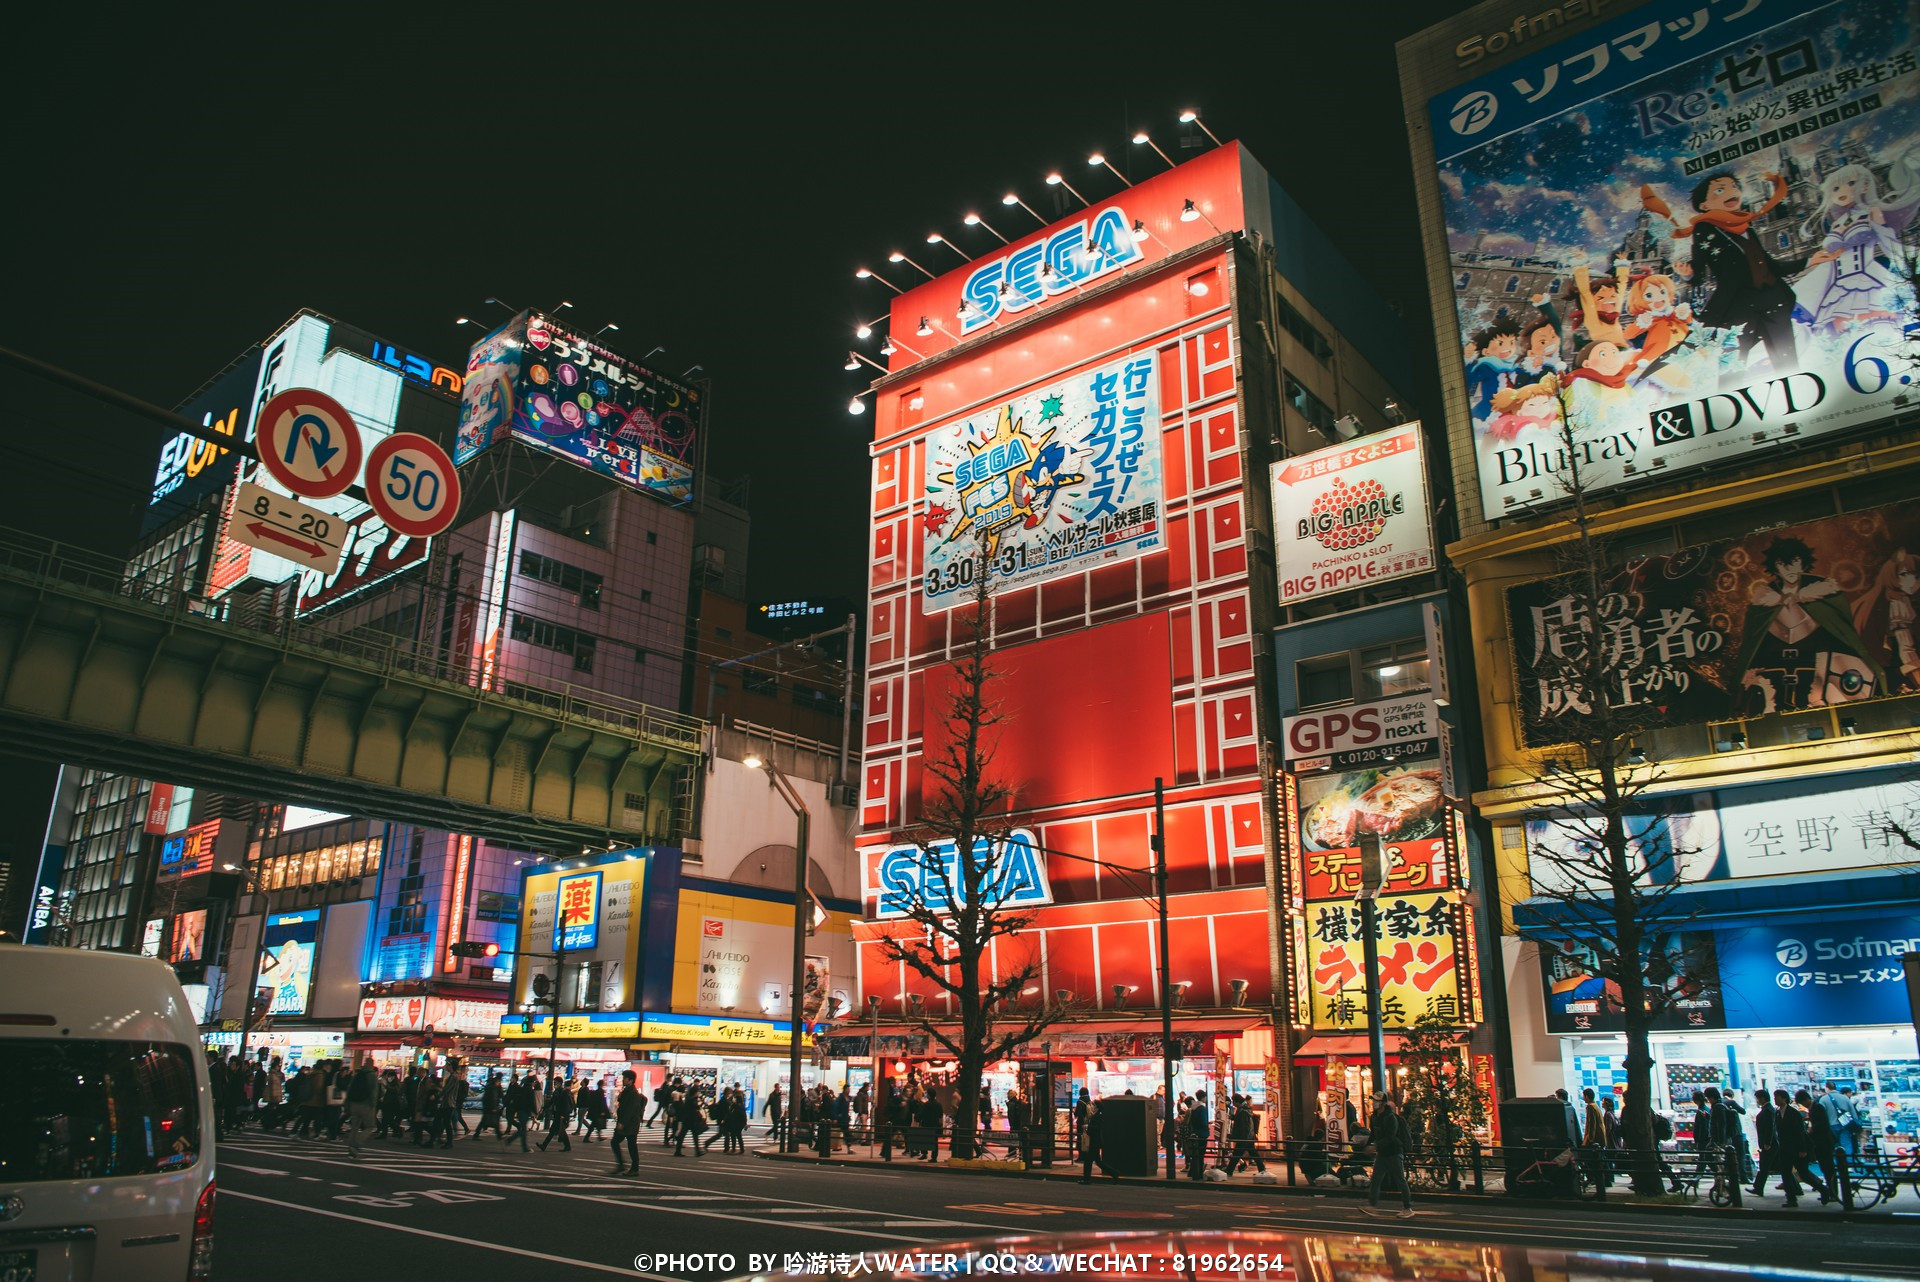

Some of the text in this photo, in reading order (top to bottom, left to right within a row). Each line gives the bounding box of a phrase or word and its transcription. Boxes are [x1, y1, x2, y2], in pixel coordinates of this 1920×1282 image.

[1689, 50, 1918, 151] から始める異世界生活
[961, 206, 1144, 336] SEGA
[551, 338, 657, 395] ラブメルシー
[1496, 426, 1644, 487] Blu-ray
[1654, 409, 1692, 442] &
[1698, 371, 1827, 436] DVD
[598, 438, 638, 462] LOVE
[1084, 372, 1119, 523] セガフェス
[1299, 438, 1402, 480] 万世橋すぐよこ!
[955, 439, 1028, 490] SEGA
[387, 455, 439, 512] 50
[965, 473, 1010, 519] FES
[974, 504, 1012, 529] 2019
[1049, 502, 1156, 546] ベルサール秋葉原
[1297, 492, 1404, 540] BIG APPLE
[1137, 536, 1159, 550] SEGA
[1311, 551, 1361, 571] PACHINKO
[1369, 543, 1393, 557] SLOT
[928, 558, 973, 595] 3.30
[1381, 555, 1429, 575] 秋葉原店
[1283, 575, 1317, 598] BIG
[1383, 701, 1427, 716] リアルタイム
[1289, 707, 1381, 754] GPS
[1385, 719, 1427, 740] next
[1348, 742, 1429, 764] 0120-915-047
[1286, 774, 1304, 894] ステーキ&ハンバーグ
[1328, 862, 1428, 894] ハンーグ
[33, 886, 55, 929] AKIBA
[564, 879, 592, 924] 薬
[607, 911, 634, 921] Kanebo
[608, 926, 631, 934] SOFINA
[704, 950, 750, 963] SHISEIDO
[649, 1027, 685, 1036] Matsumoto
[717, 1024, 767, 1040] マツモトキヨシ
[1264, 1062, 1280, 1082] 29
[1326, 1061, 1346, 1082] 29
